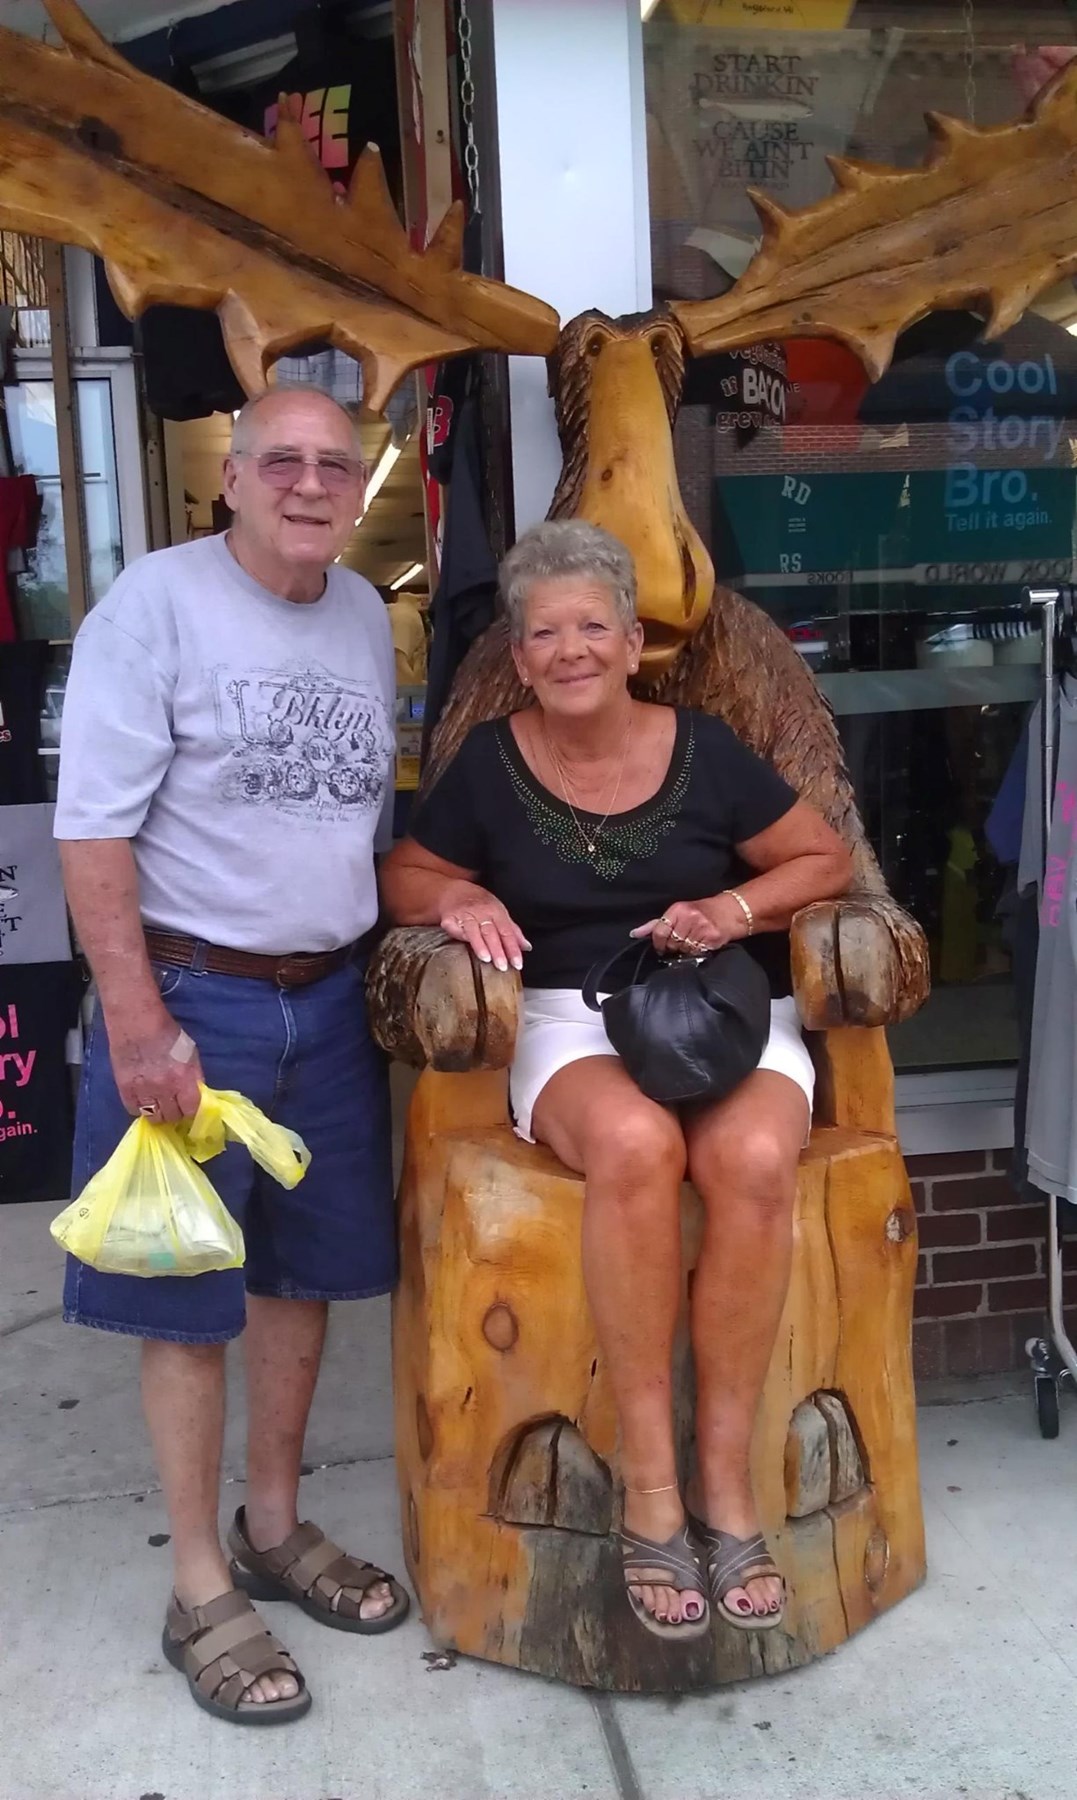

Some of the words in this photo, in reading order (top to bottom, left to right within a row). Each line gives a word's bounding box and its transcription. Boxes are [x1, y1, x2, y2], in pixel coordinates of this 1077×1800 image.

[713, 54, 802, 74] START
[713, 120, 799, 140] CAUSE
[746, 140, 815, 160] AIN'T
[945, 351, 1057, 396] Cool
[947, 405, 1066, 461] Story
[944, 461, 1038, 507] Bro.
[945, 510, 980, 532] Tell
[985, 509, 998, 529] it
[1003, 506, 1053, 531] again.
